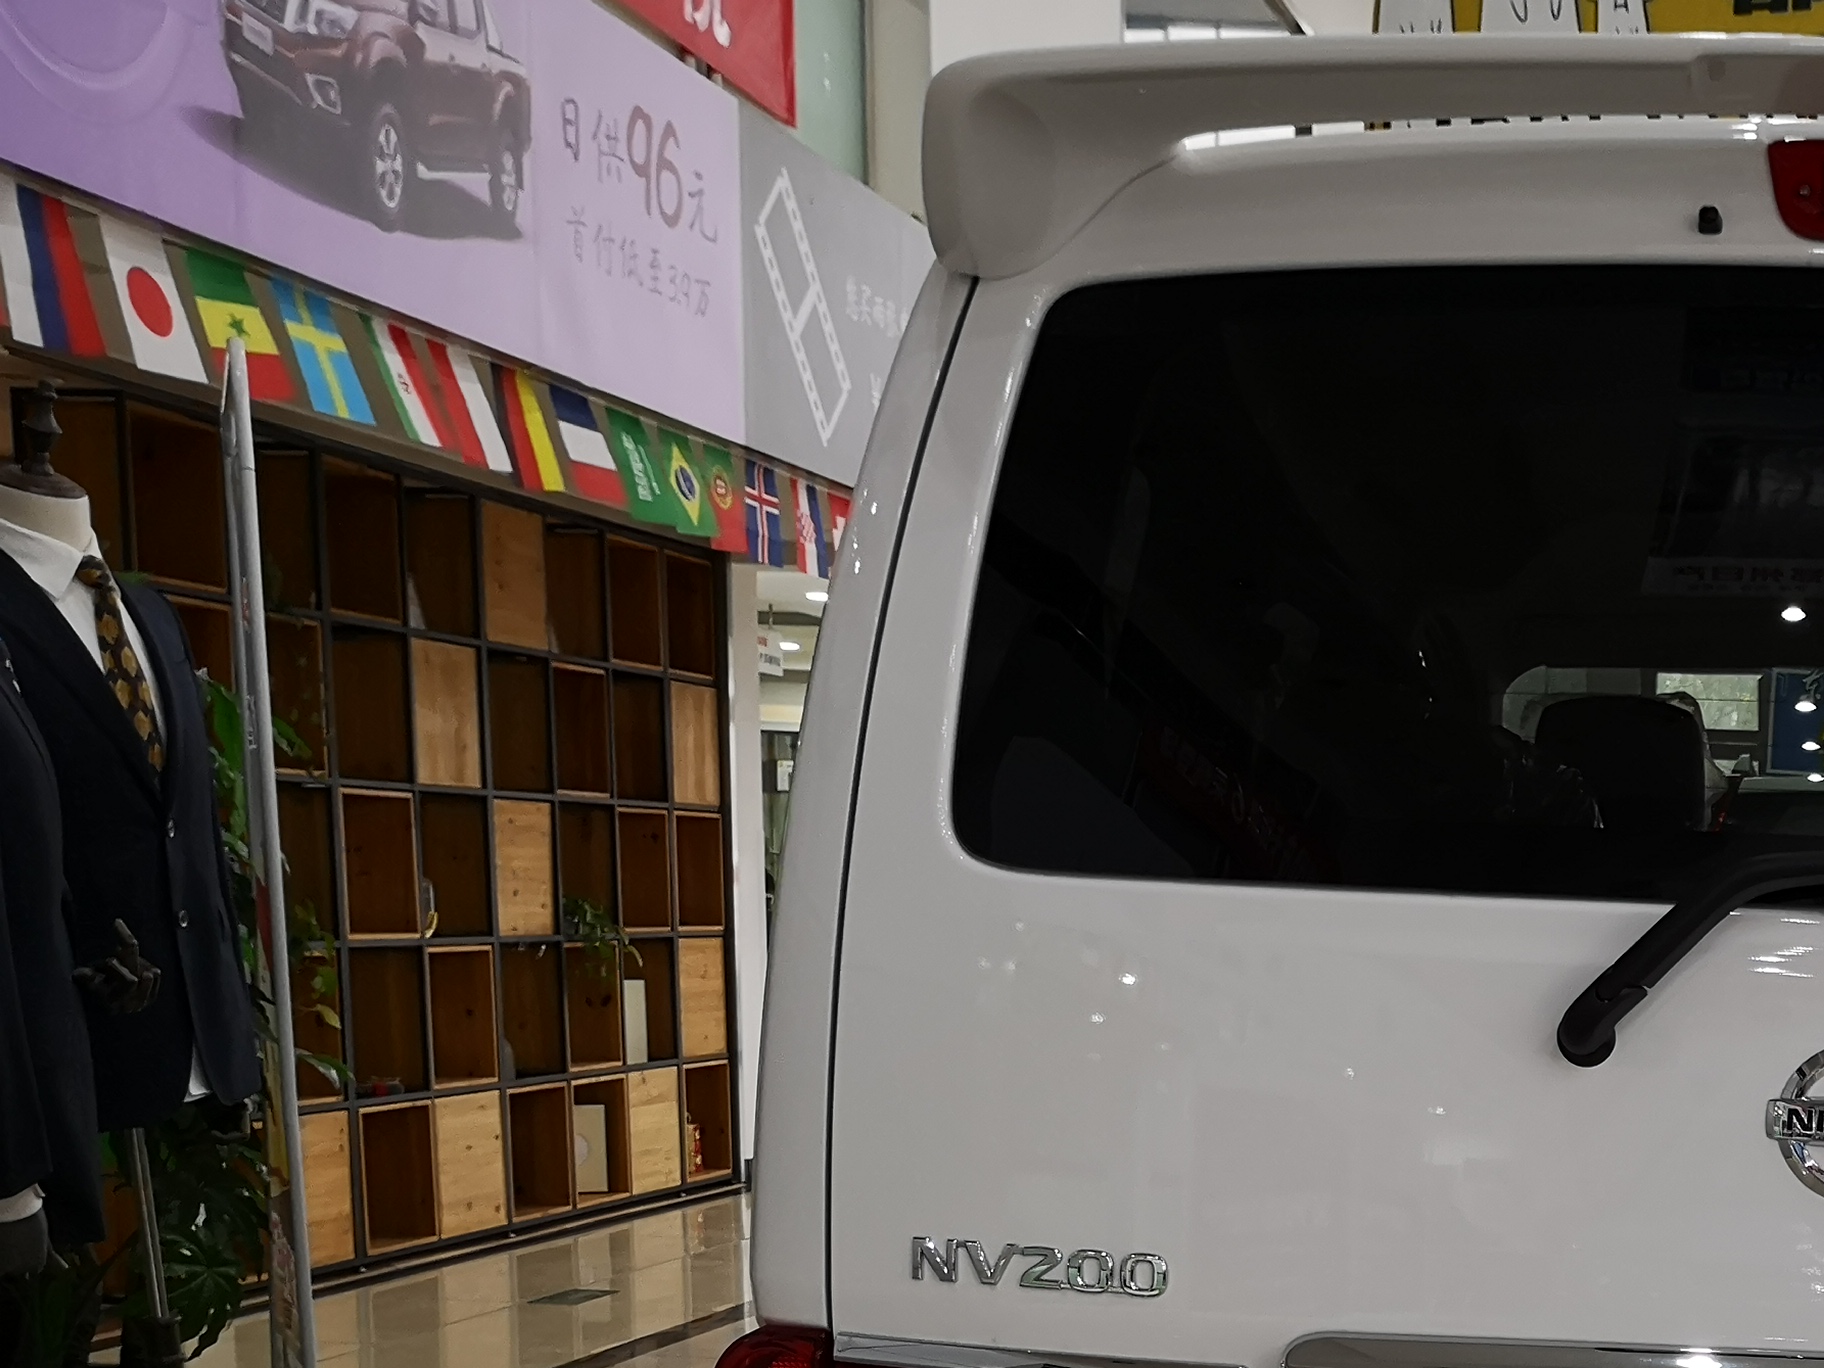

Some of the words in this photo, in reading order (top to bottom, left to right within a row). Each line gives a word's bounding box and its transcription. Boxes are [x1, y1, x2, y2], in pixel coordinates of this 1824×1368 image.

[562, 97, 718, 243] 日供96元
[911, 1236, 1168, 1298] NV200
